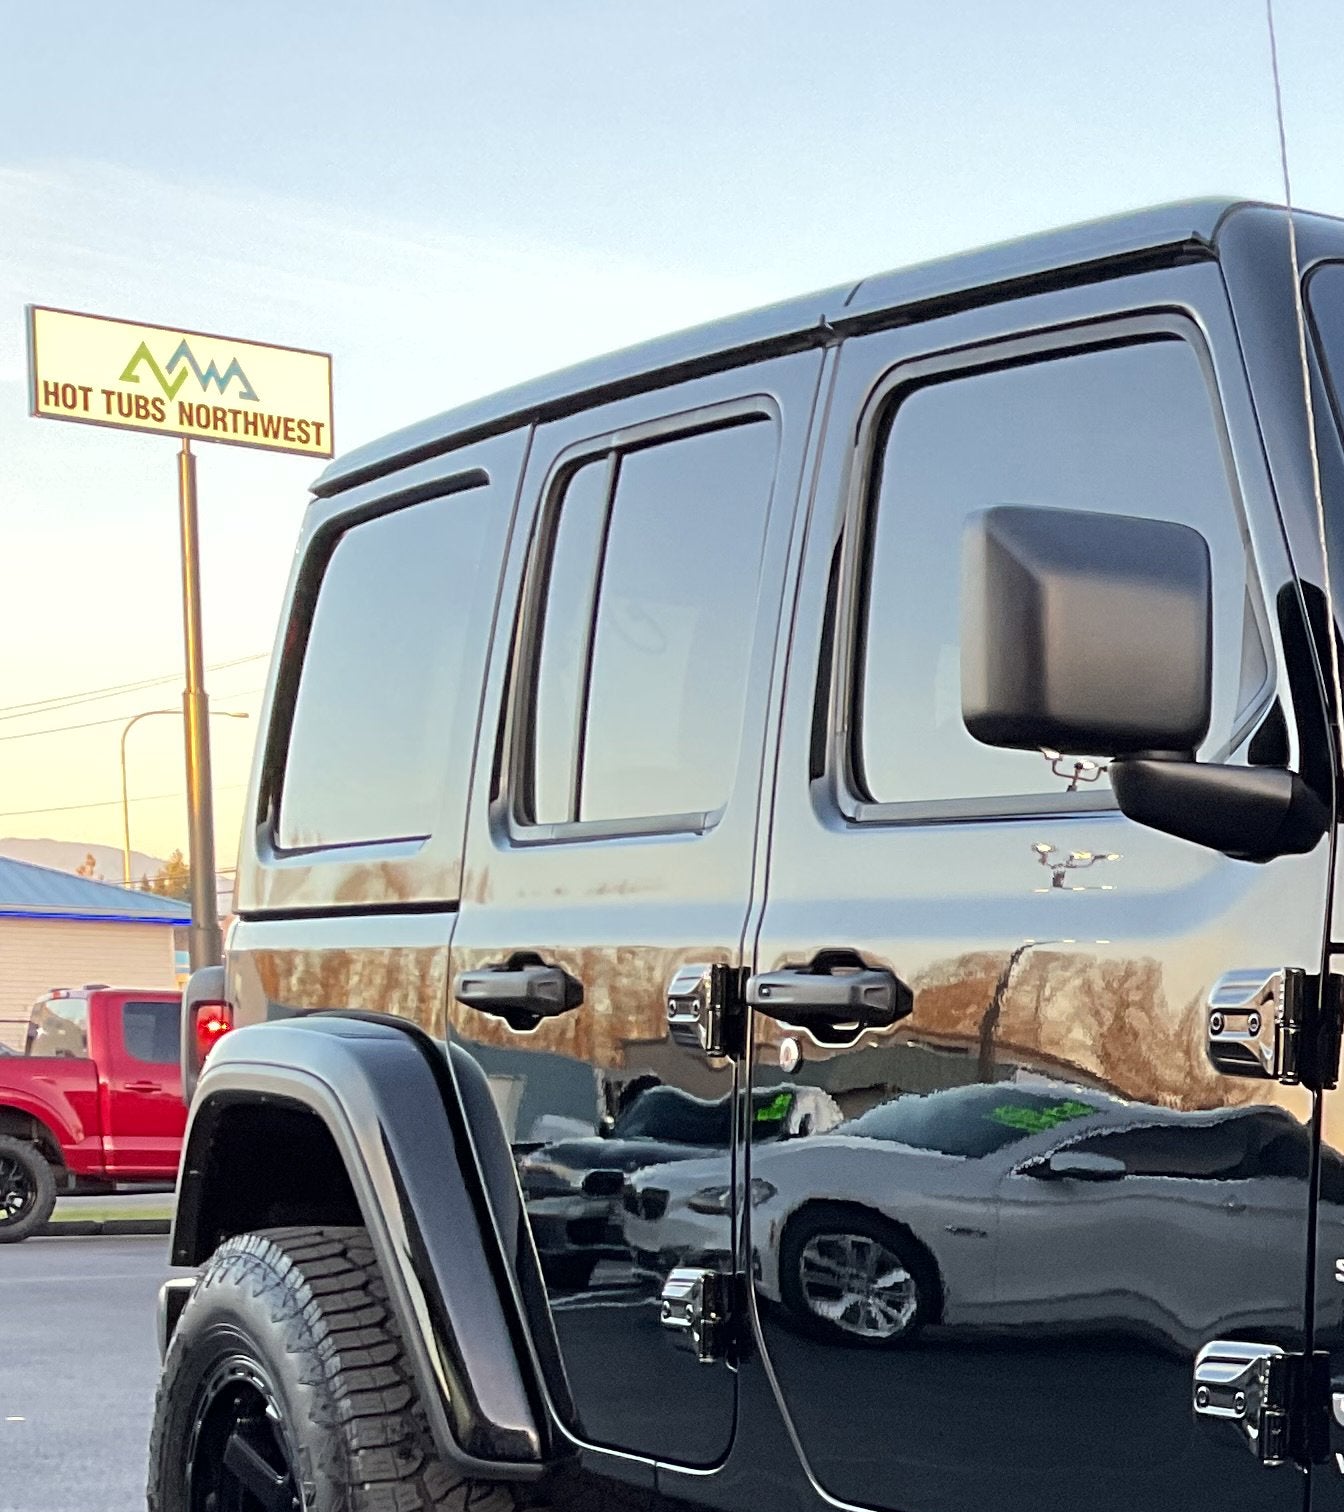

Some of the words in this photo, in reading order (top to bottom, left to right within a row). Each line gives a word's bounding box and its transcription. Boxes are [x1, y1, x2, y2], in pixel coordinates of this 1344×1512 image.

[43, 380, 93, 412] HOT
[101, 388, 166, 423] TUBS
[178, 401, 325, 446] NORTHWEST
